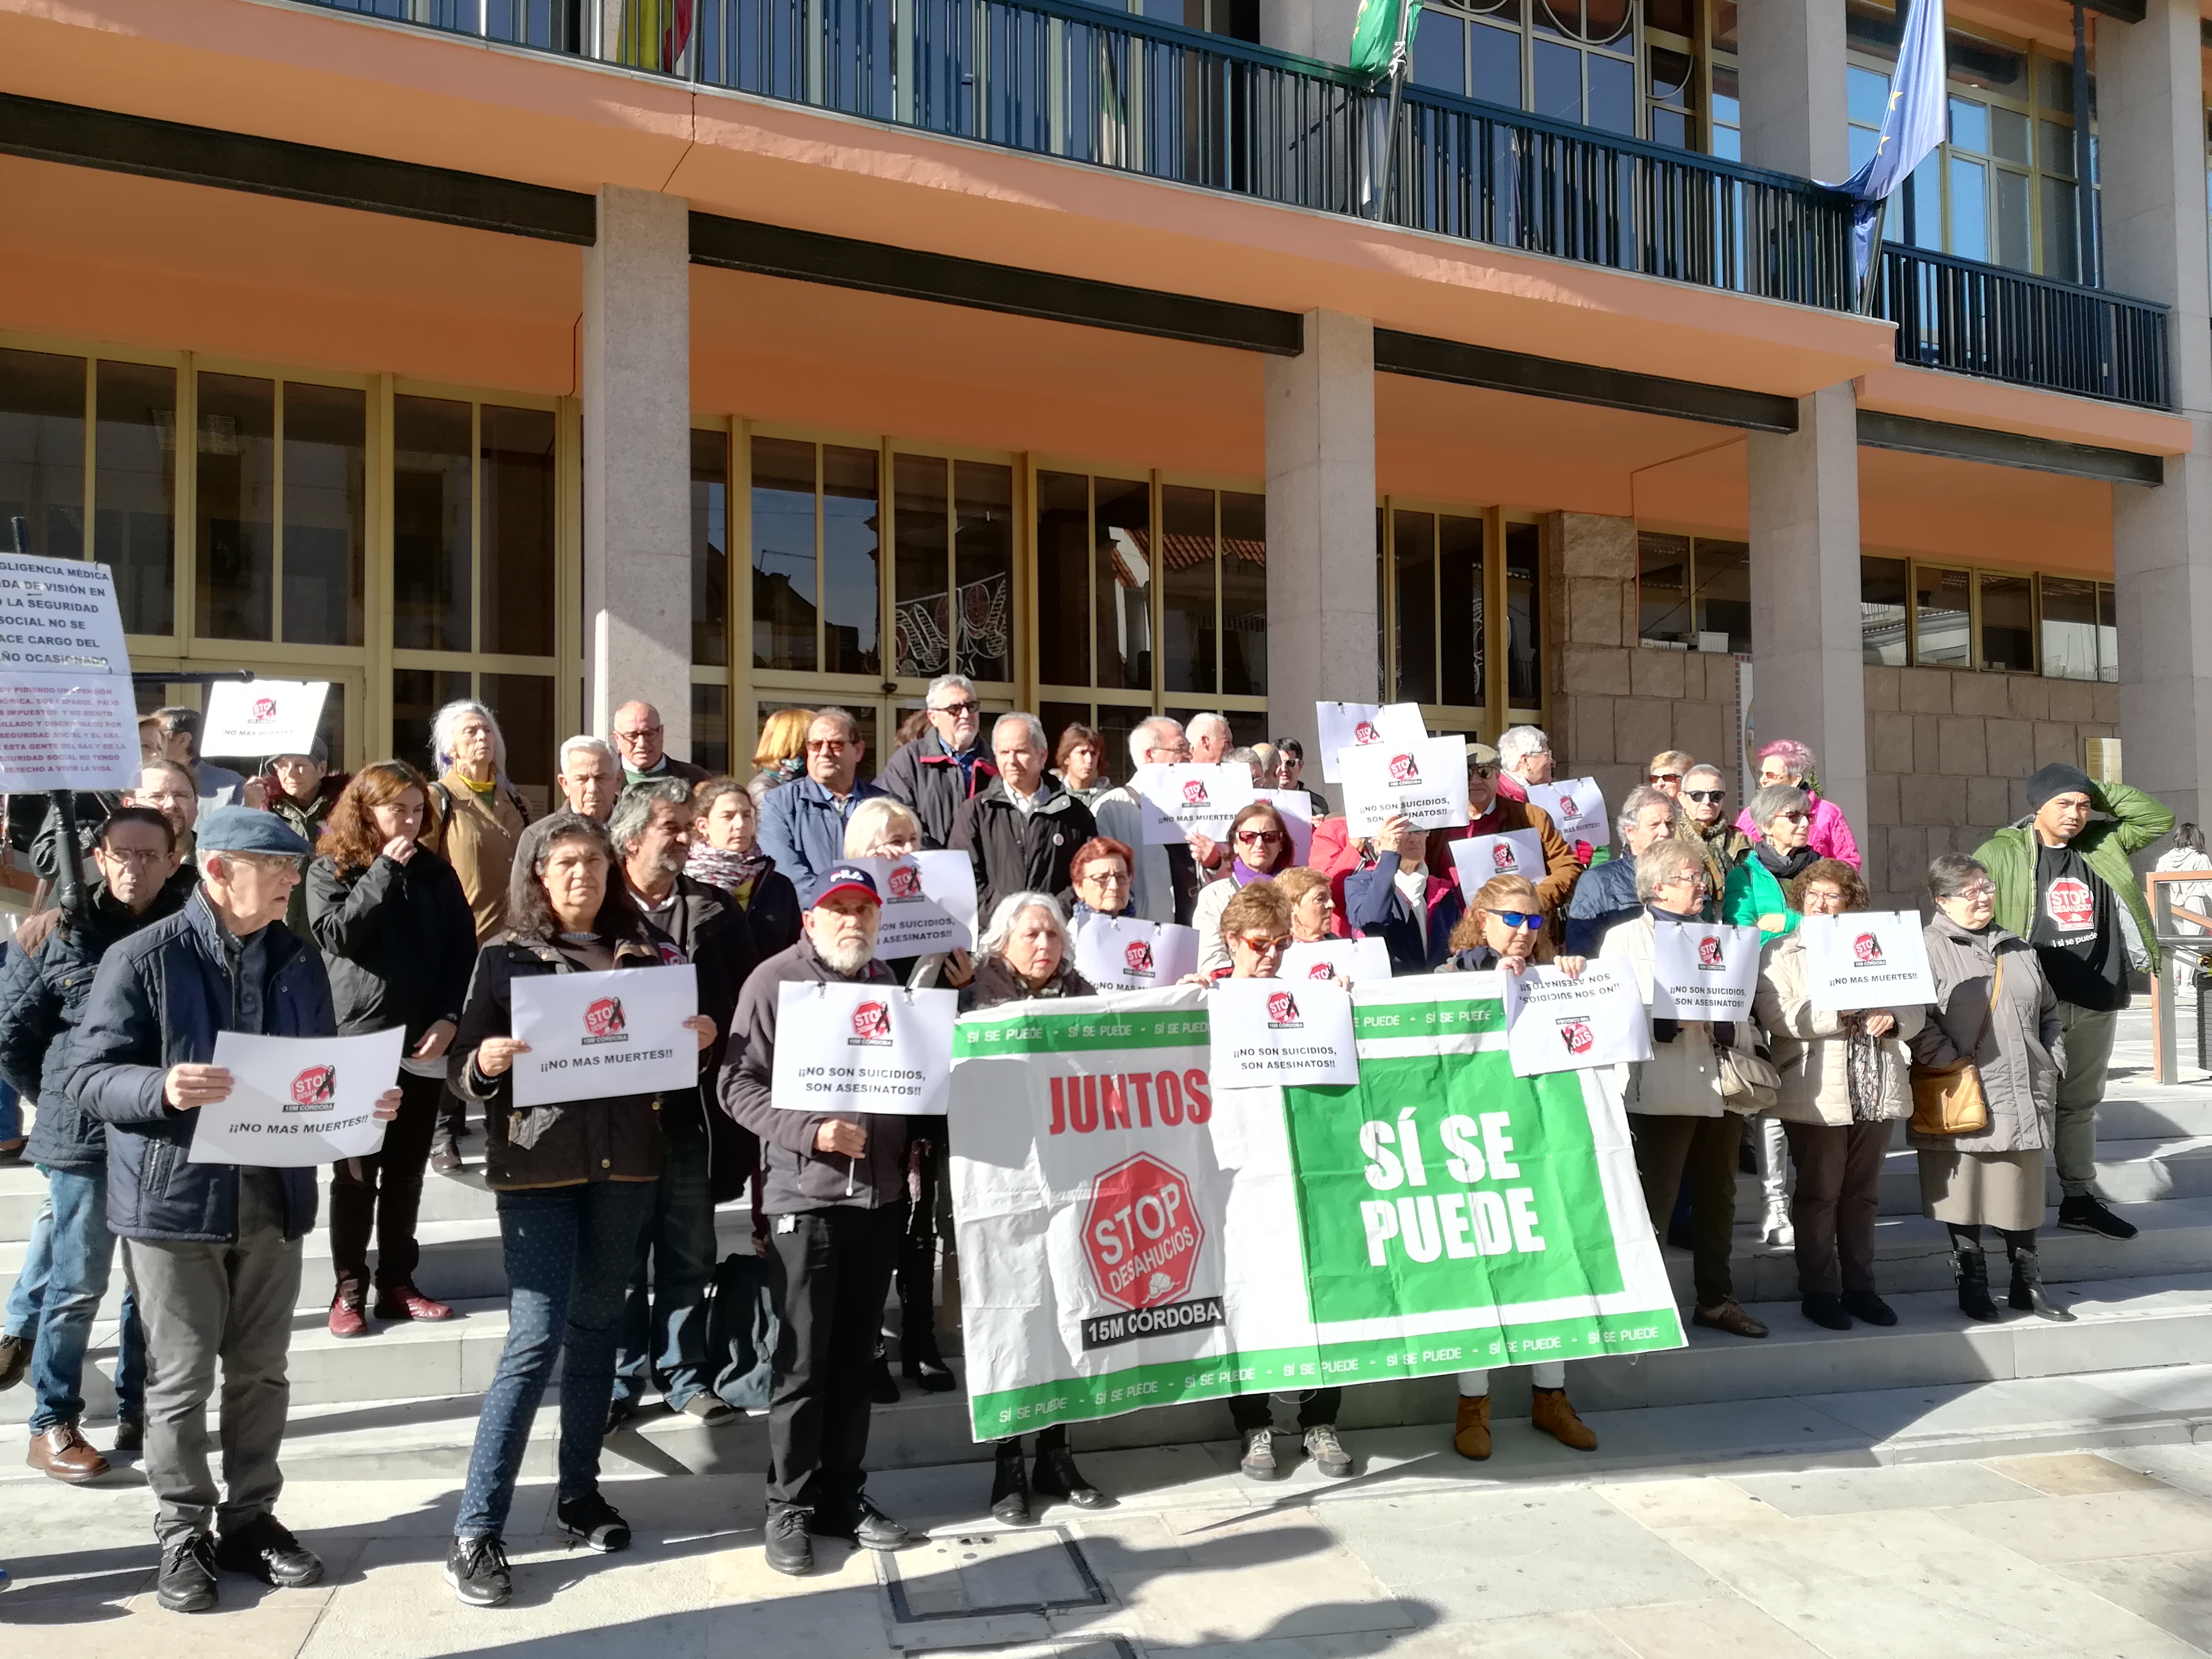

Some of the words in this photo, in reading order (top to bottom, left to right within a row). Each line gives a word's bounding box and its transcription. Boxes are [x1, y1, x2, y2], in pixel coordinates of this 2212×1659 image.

[67, 568, 109, 581] MÉDICA
[25, 581, 41, 590] DE
[43, 583, 85, 595] VISIÓN
[90, 588, 106, 596] EN
[7, 598, 24, 608] LA
[28, 599, 99, 613] SEGURIDAD
[49, 619, 66, 628] NO
[70, 620, 85, 630] SE
[28, 636, 72, 646] CARGO
[76, 638, 100, 648] DEL
[1401, 798, 1450, 808] SUICIDIOS,
[831, 869, 864, 882] FILA
[2051, 889, 2089, 906] STOP
[2053, 904, 2093, 914] DESAHUCIOS
[899, 918, 955, 929] SUICIDIOS,
[883, 930, 952, 944] ASESINATOS!!
[2075, 932, 2098, 945] puede
[1700, 942, 1717, 956] STO
[1856, 938, 1874, 953] STO
[1520, 978, 1584, 992] ASESINATOS!!
[1589, 973, 1610, 983] SON
[1830, 978, 1847, 987] ¡¡NO
[1871, 972, 1918, 982] MUERTES!!
[1519, 992, 1572, 1004] SUICIDIOS,
[1575, 989, 1595, 998] SON
[1707, 987, 1747, 998] SUICIDIOS,
[1269, 997, 1290, 1013] STO
[1695, 999, 1744, 1008] ASESINATOS!!
[587, 1005, 615, 1026] STO
[855, 1008, 882, 1027] STO
[1364, 1015, 1400, 1027] PUEDE
[1425, 1011, 1435, 1023] SÍ
[1439, 1012, 1454, 1023] SE
[1458, 1010, 1491, 1021] PUEDE
[967, 1030, 979, 1043] SÍ
[984, 1030, 1000, 1042] SE
[1006, 1027, 1043, 1040] PUEDE
[1068, 1025, 1079, 1038] SÍ
[1083, 1025, 1095, 1037] SE
[1100, 1023, 1132, 1037] PUEDE
[1154, 1021, 1164, 1035] SÍ
[1167, 1022, 1179, 1034] SE
[1234, 1049, 1254, 1058] ¡¡NO
[1282, 1047, 1337, 1056] SUICIDIOS,
[541, 1060, 567, 1073] ¡¡NO
[573, 1056, 600, 1068] MAS
[604, 1049, 673, 1064] MUERTES!!
[1267, 1060, 1335, 1069] ASESINATOS!!
[798, 1067, 824, 1078] ¡¡NO
[828, 1068, 855, 1077] SON
[858, 1069, 925, 1082] SUICIDIOS,
[296, 1073, 326, 1093] STO
[806, 1083, 832, 1092] SON
[836, 1084, 921, 1095] ASESINATOS!!
[1049, 1069, 1212, 1136] JUNTOS
[229, 1123, 262, 1134] ¡¡NO
[267, 1125, 298, 1134] MAS
[303, 1115, 368, 1133] MUERTES!!
[1359, 1107, 1428, 1191] SÍ
[1440, 1111, 1521, 1185] SE
[1094, 1182, 1181, 1265] STOP
[1360, 1187, 1546, 1267] PUEDE
[1108, 1225, 1195, 1294] DESAHUCIOS
[1088, 1318, 1124, 1343] 15M
[1127, 1301, 1223, 1335] CÓRDOBA
[1000, 1409, 1012, 1423] SÍ
[1017, 1407, 1030, 1420] SE
[1035, 1398, 1068, 1415] PUEDE
[1095, 1391, 1106, 1405] SÍ
[1111, 1390, 1123, 1402] SE
[1127, 1381, 1158, 1399] PUEDE
[1185, 1374, 1196, 1388] SÍ
[1200, 1373, 1214, 1386] SE
[1219, 1368, 1256, 1384] PUEDE
[1283, 1362, 1295, 1377] SÍ
[1299, 1362, 1316, 1376] SE
[1321, 1358, 1359, 1374] PUEDE
[1386, 1352, 1398, 1367] SÍ
[1403, 1352, 1418, 1366] SE
[1423, 1347, 1462, 1363] PUEDE
[1490, 1340, 1501, 1355] SÍ
[1505, 1340, 1518, 1354] SE
[1524, 1336, 1561, 1351] PUEDE
[1588, 1329, 1600, 1345] SÍ
[1603, 1329, 1615, 1343] SE
[1621, 1326, 1659, 1342] PUEDE
